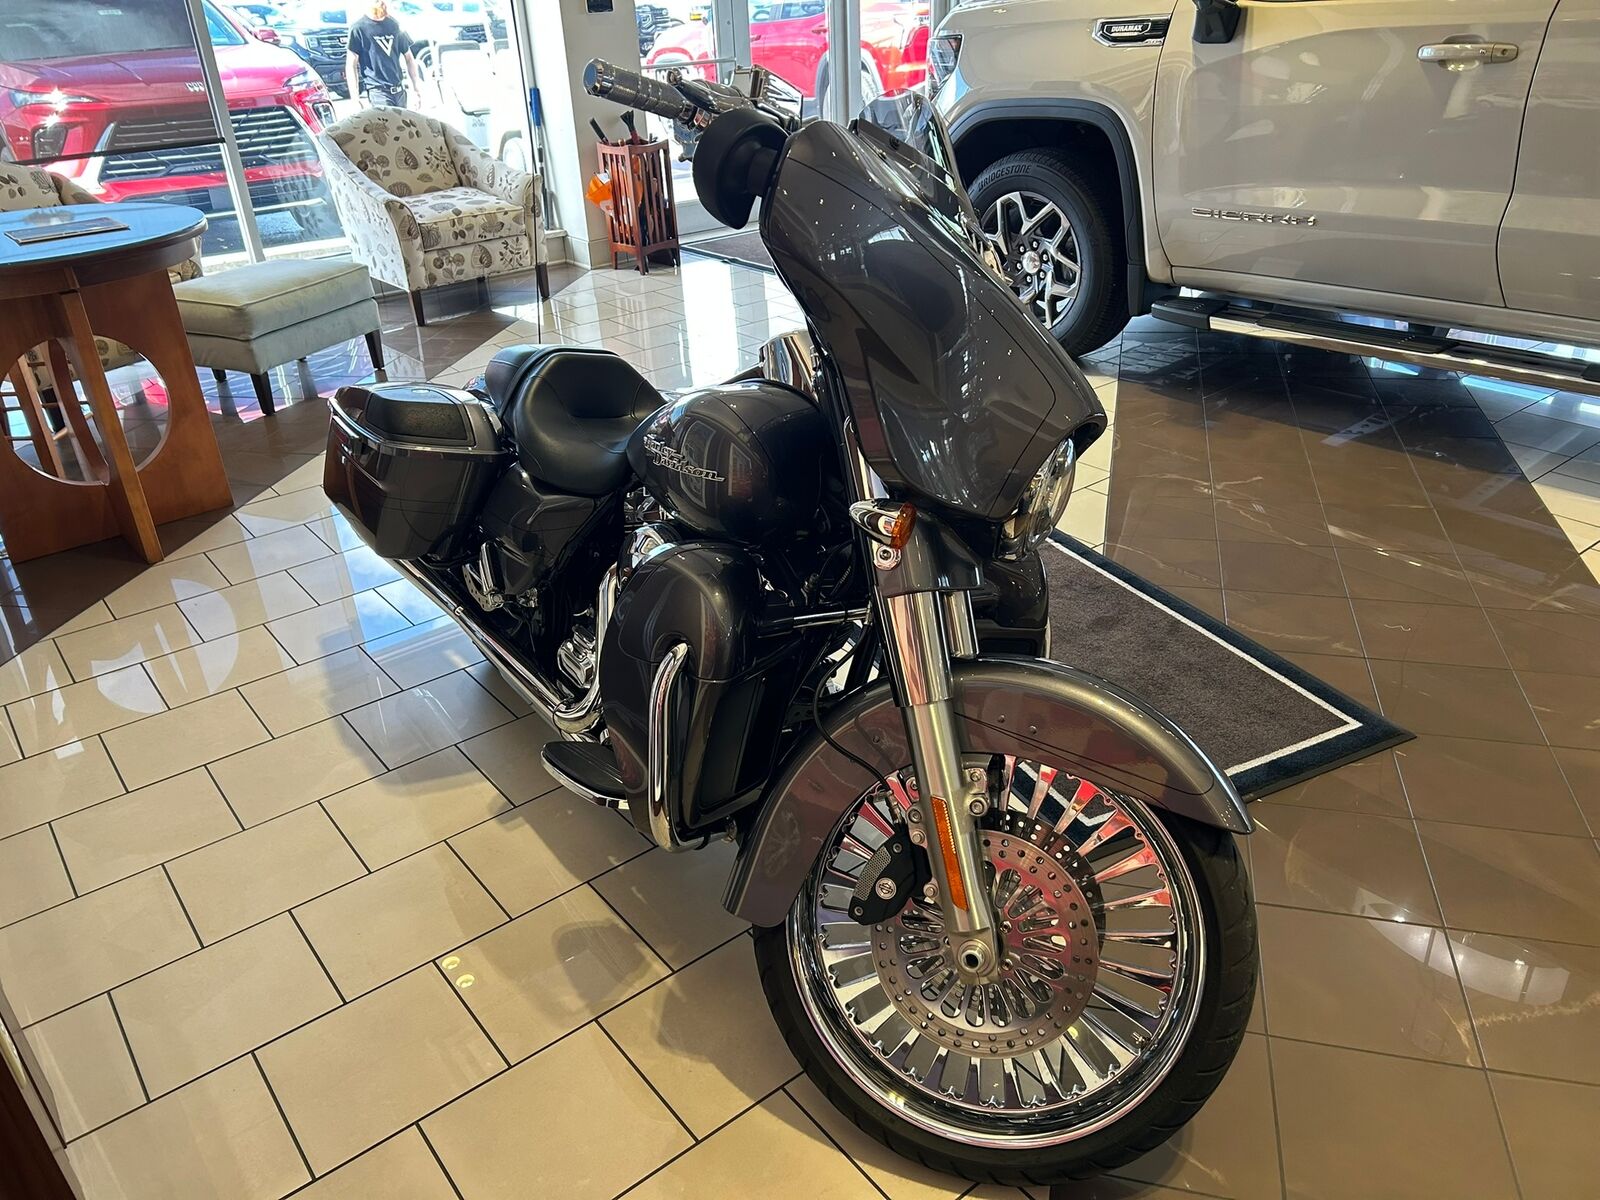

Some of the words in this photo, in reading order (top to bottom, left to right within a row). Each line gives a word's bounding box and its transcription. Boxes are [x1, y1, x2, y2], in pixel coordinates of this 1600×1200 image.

[1110, 24, 1144, 33] DURAMAX
[978, 164, 1032, 192] BRIDGESTONE
[1191, 206, 1316, 226] SIERRA
